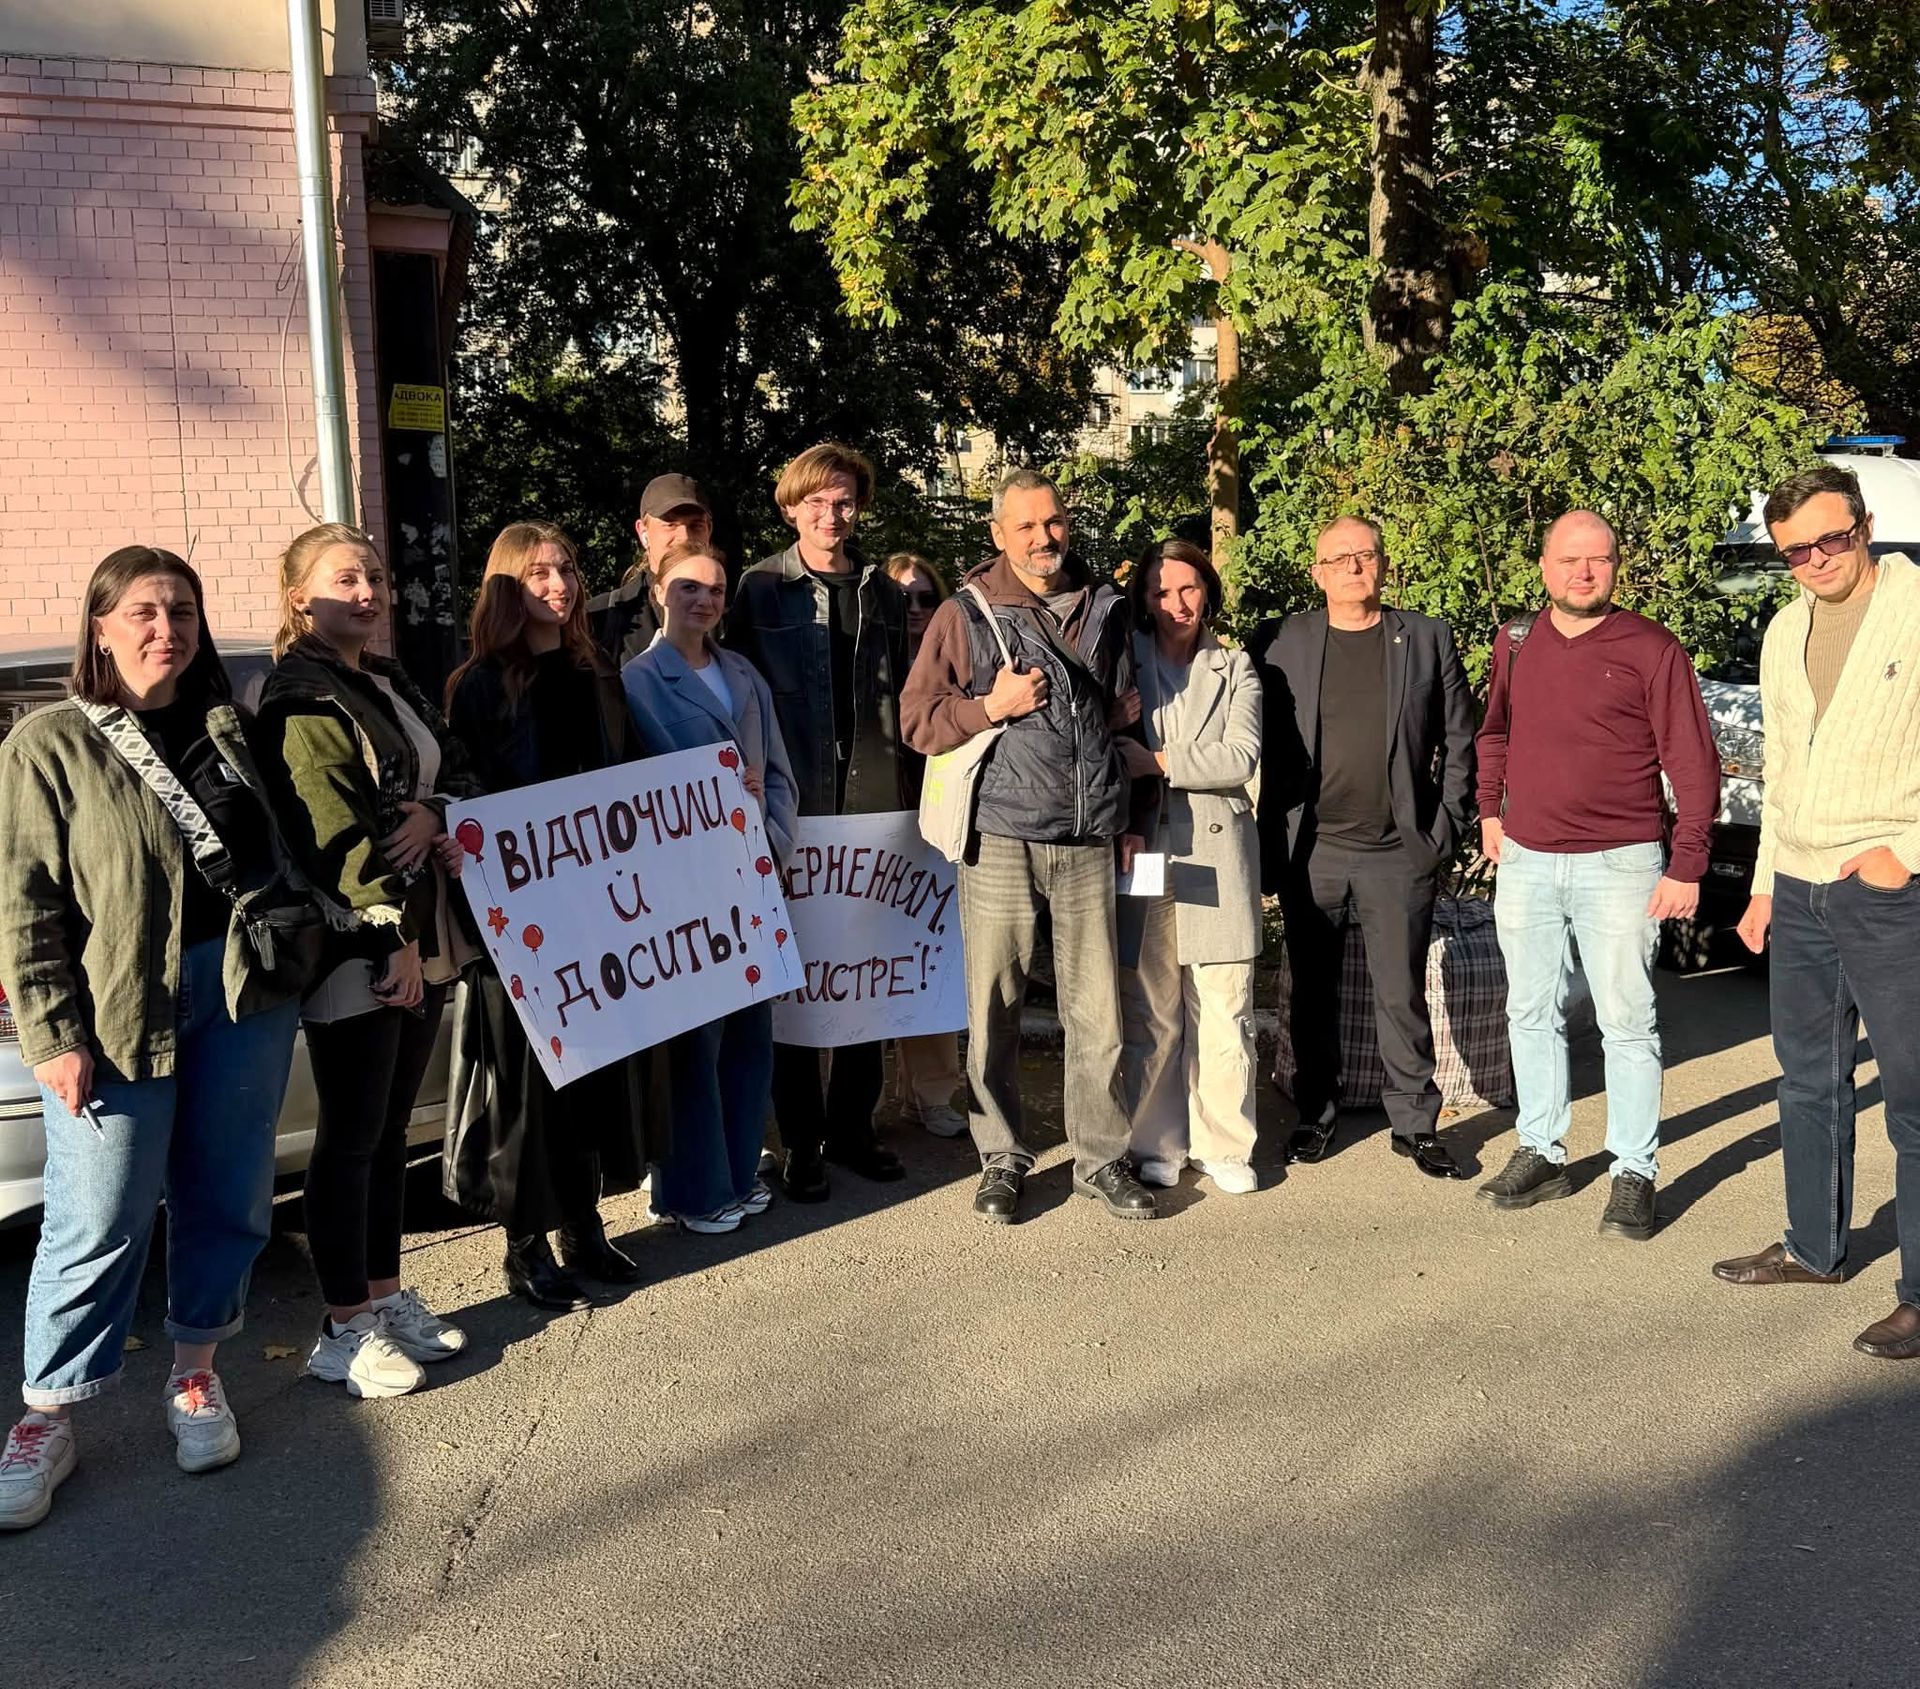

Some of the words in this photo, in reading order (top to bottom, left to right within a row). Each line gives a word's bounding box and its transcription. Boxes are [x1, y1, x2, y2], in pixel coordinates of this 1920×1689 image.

[494, 775, 728, 893] ВІДПОЧИЛИ
[606, 869, 651, 923] Й
[780, 845, 956, 937] ЕРНЕННЯМ,
[553, 904, 748, 1028] ДОСИТЬ!
[775, 944, 930, 1005] ЙСТРЕ!
